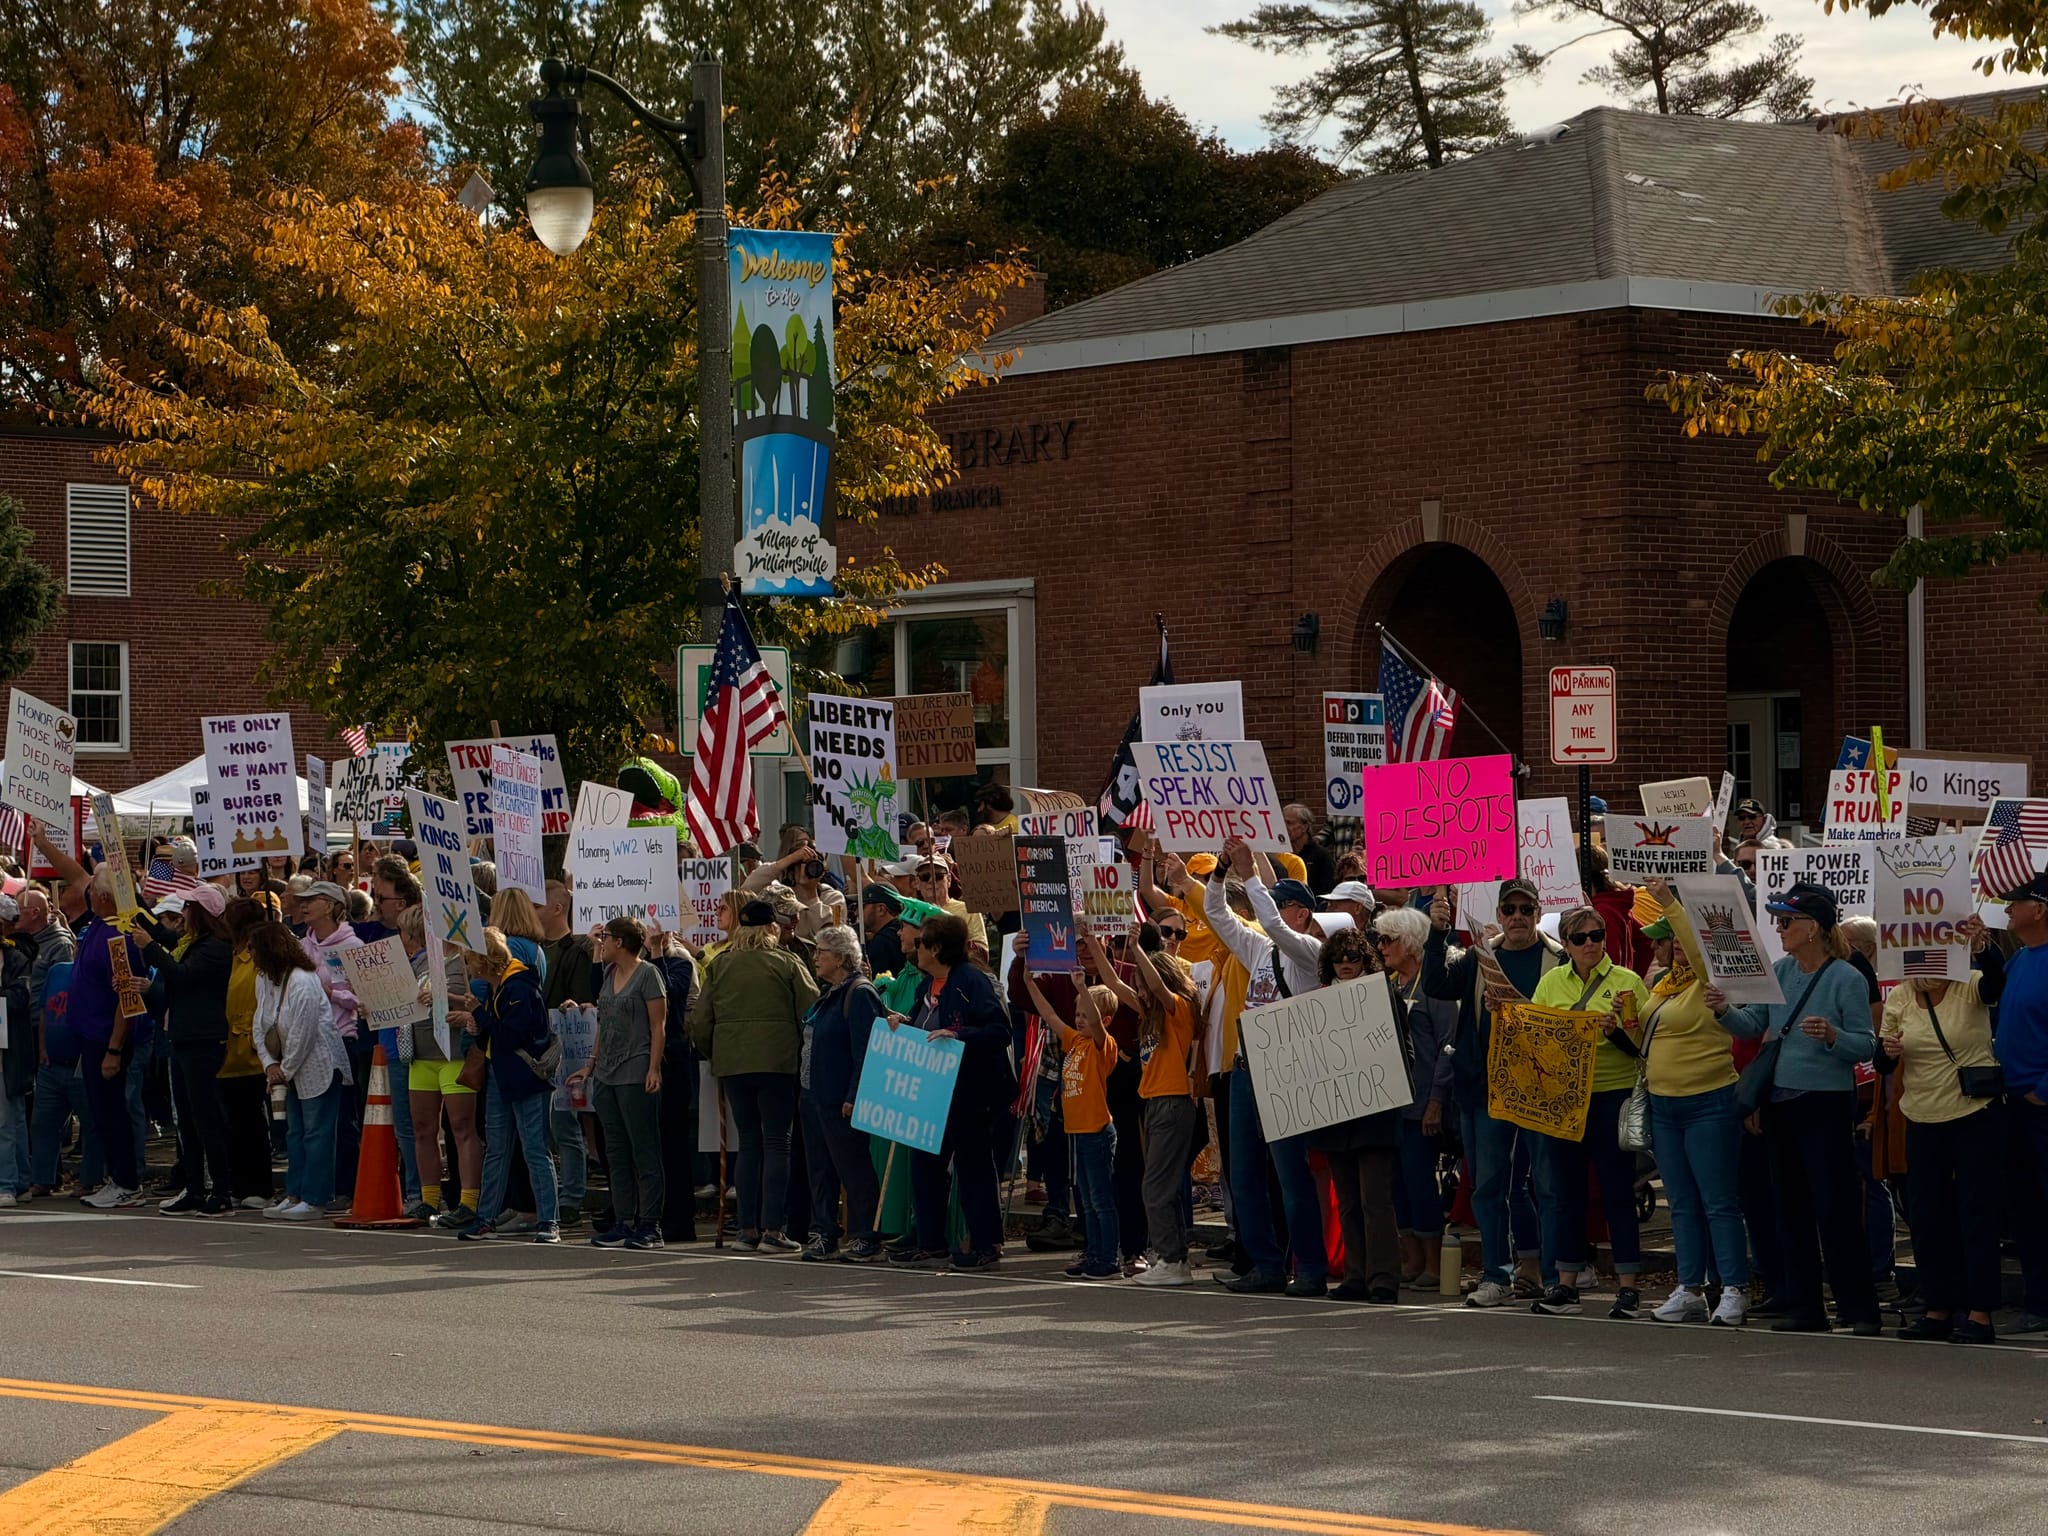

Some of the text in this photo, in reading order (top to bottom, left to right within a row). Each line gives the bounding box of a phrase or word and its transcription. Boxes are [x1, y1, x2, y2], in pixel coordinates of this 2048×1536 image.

[735, 245, 827, 288] Welcome
[765, 284, 801, 311] to the
[754, 529, 818, 557] Village of
[745, 552, 829, 575] Williamsville
[1552, 674, 1610, 692] NO PARKING
[17, 696, 54, 728] HONOR
[922, 696, 942, 709] ARE
[946, 694, 970, 707] NOT
[1160, 702, 1224, 718] Only YOU
[1329, 703, 1377, 721] npr
[1571, 703, 1594, 716] ANY
[208, 718, 281, 734] THE ONLY
[809, 699, 893, 732] LIBERTY
[897, 709, 953, 729] ANGRY
[16, 720, 74, 755] THOSE WHO
[898, 726, 973, 743] HAVEN'T PAID
[1327, 731, 1385, 745] DEFEND TRUTH
[1571, 727, 1597, 739] TIME
[814, 729, 886, 760] NEEDS
[896, 741, 976, 766] TENTION
[1330, 746, 1382, 760] SAVE PUBLIC
[22, 743, 72, 777] DIED FOR
[347, 754, 378, 777] NOT
[508, 751, 521, 765] THE
[813, 755, 842, 781] NO
[1155, 743, 1237, 773] RESIST
[22, 765, 50, 787] OUR
[218, 762, 288, 778] WE WANT
[517, 764, 538, 785] DANGER
[246, 779, 261, 791] IS
[1149, 776, 1269, 806] SPEAK OUT
[1417, 762, 1470, 800] NO
[1944, 772, 2001, 802] Kings
[8, 775, 65, 815] FREEDOM
[223, 793, 283, 811] BURGER
[346, 790, 370, 803] ANTI
[579, 785, 622, 826] NO
[333, 799, 385, 823] FASCIST
[422, 796, 445, 821] NO
[812, 783, 859, 840] KING
[1656, 802, 1696, 814] WAS NOT A
[1064, 810, 1095, 838] OUR
[1379, 794, 1513, 844] DESPOTS
[418, 822, 461, 852] KINGS
[503, 833, 521, 850] THE
[1827, 828, 1901, 840] Make America
[578, 839, 663, 863] Honoring WW2 Vets
[1612, 847, 1707, 860] WE HAVE FRIENDS
[436, 853, 453, 876] IN
[683, 860, 728, 881] HONK
[1020, 864, 1036, 878] ARE
[1613, 858, 1707, 874] EVERYWHERE
[1761, 853, 1861, 871] THE POWER
[575, 877, 588, 890] who
[592, 877, 615, 889] defended
[1021, 881, 1067, 896] GOVERNING
[1093, 866, 1119, 890] NO
[1768, 869, 1870, 888] OF THE PEOPLE
[435, 876, 471, 904] USA!
[699, 882, 711, 896] TO
[1023, 899, 1060, 913] AMERICA
[1083, 890, 1134, 916] KINGS
[1903, 887, 1944, 916] NO
[579, 906, 594, 922] MY
[598, 905, 623, 921] TURN
[627, 904, 647, 920] NOW
[698, 914, 715, 928] THE
[1094, 924, 1111, 932] SINCE
[1880, 919, 1970, 950] KINGS
[345, 940, 392, 961] FREEDOM
[355, 952, 389, 970] PEACE
[1725, 955, 1759, 966] KINGS
[1723, 965, 1763, 974] AMERICA
[371, 1002, 415, 1023] PROTEST
[1254, 983, 1368, 1050] STAND UP
[871, 1029, 957, 1076] UNTRUMP
[1263, 1021, 1394, 1091] AGAINST THE
[884, 1069, 922, 1101] THE
[1270, 1063, 1395, 1137] DICKTATOR
